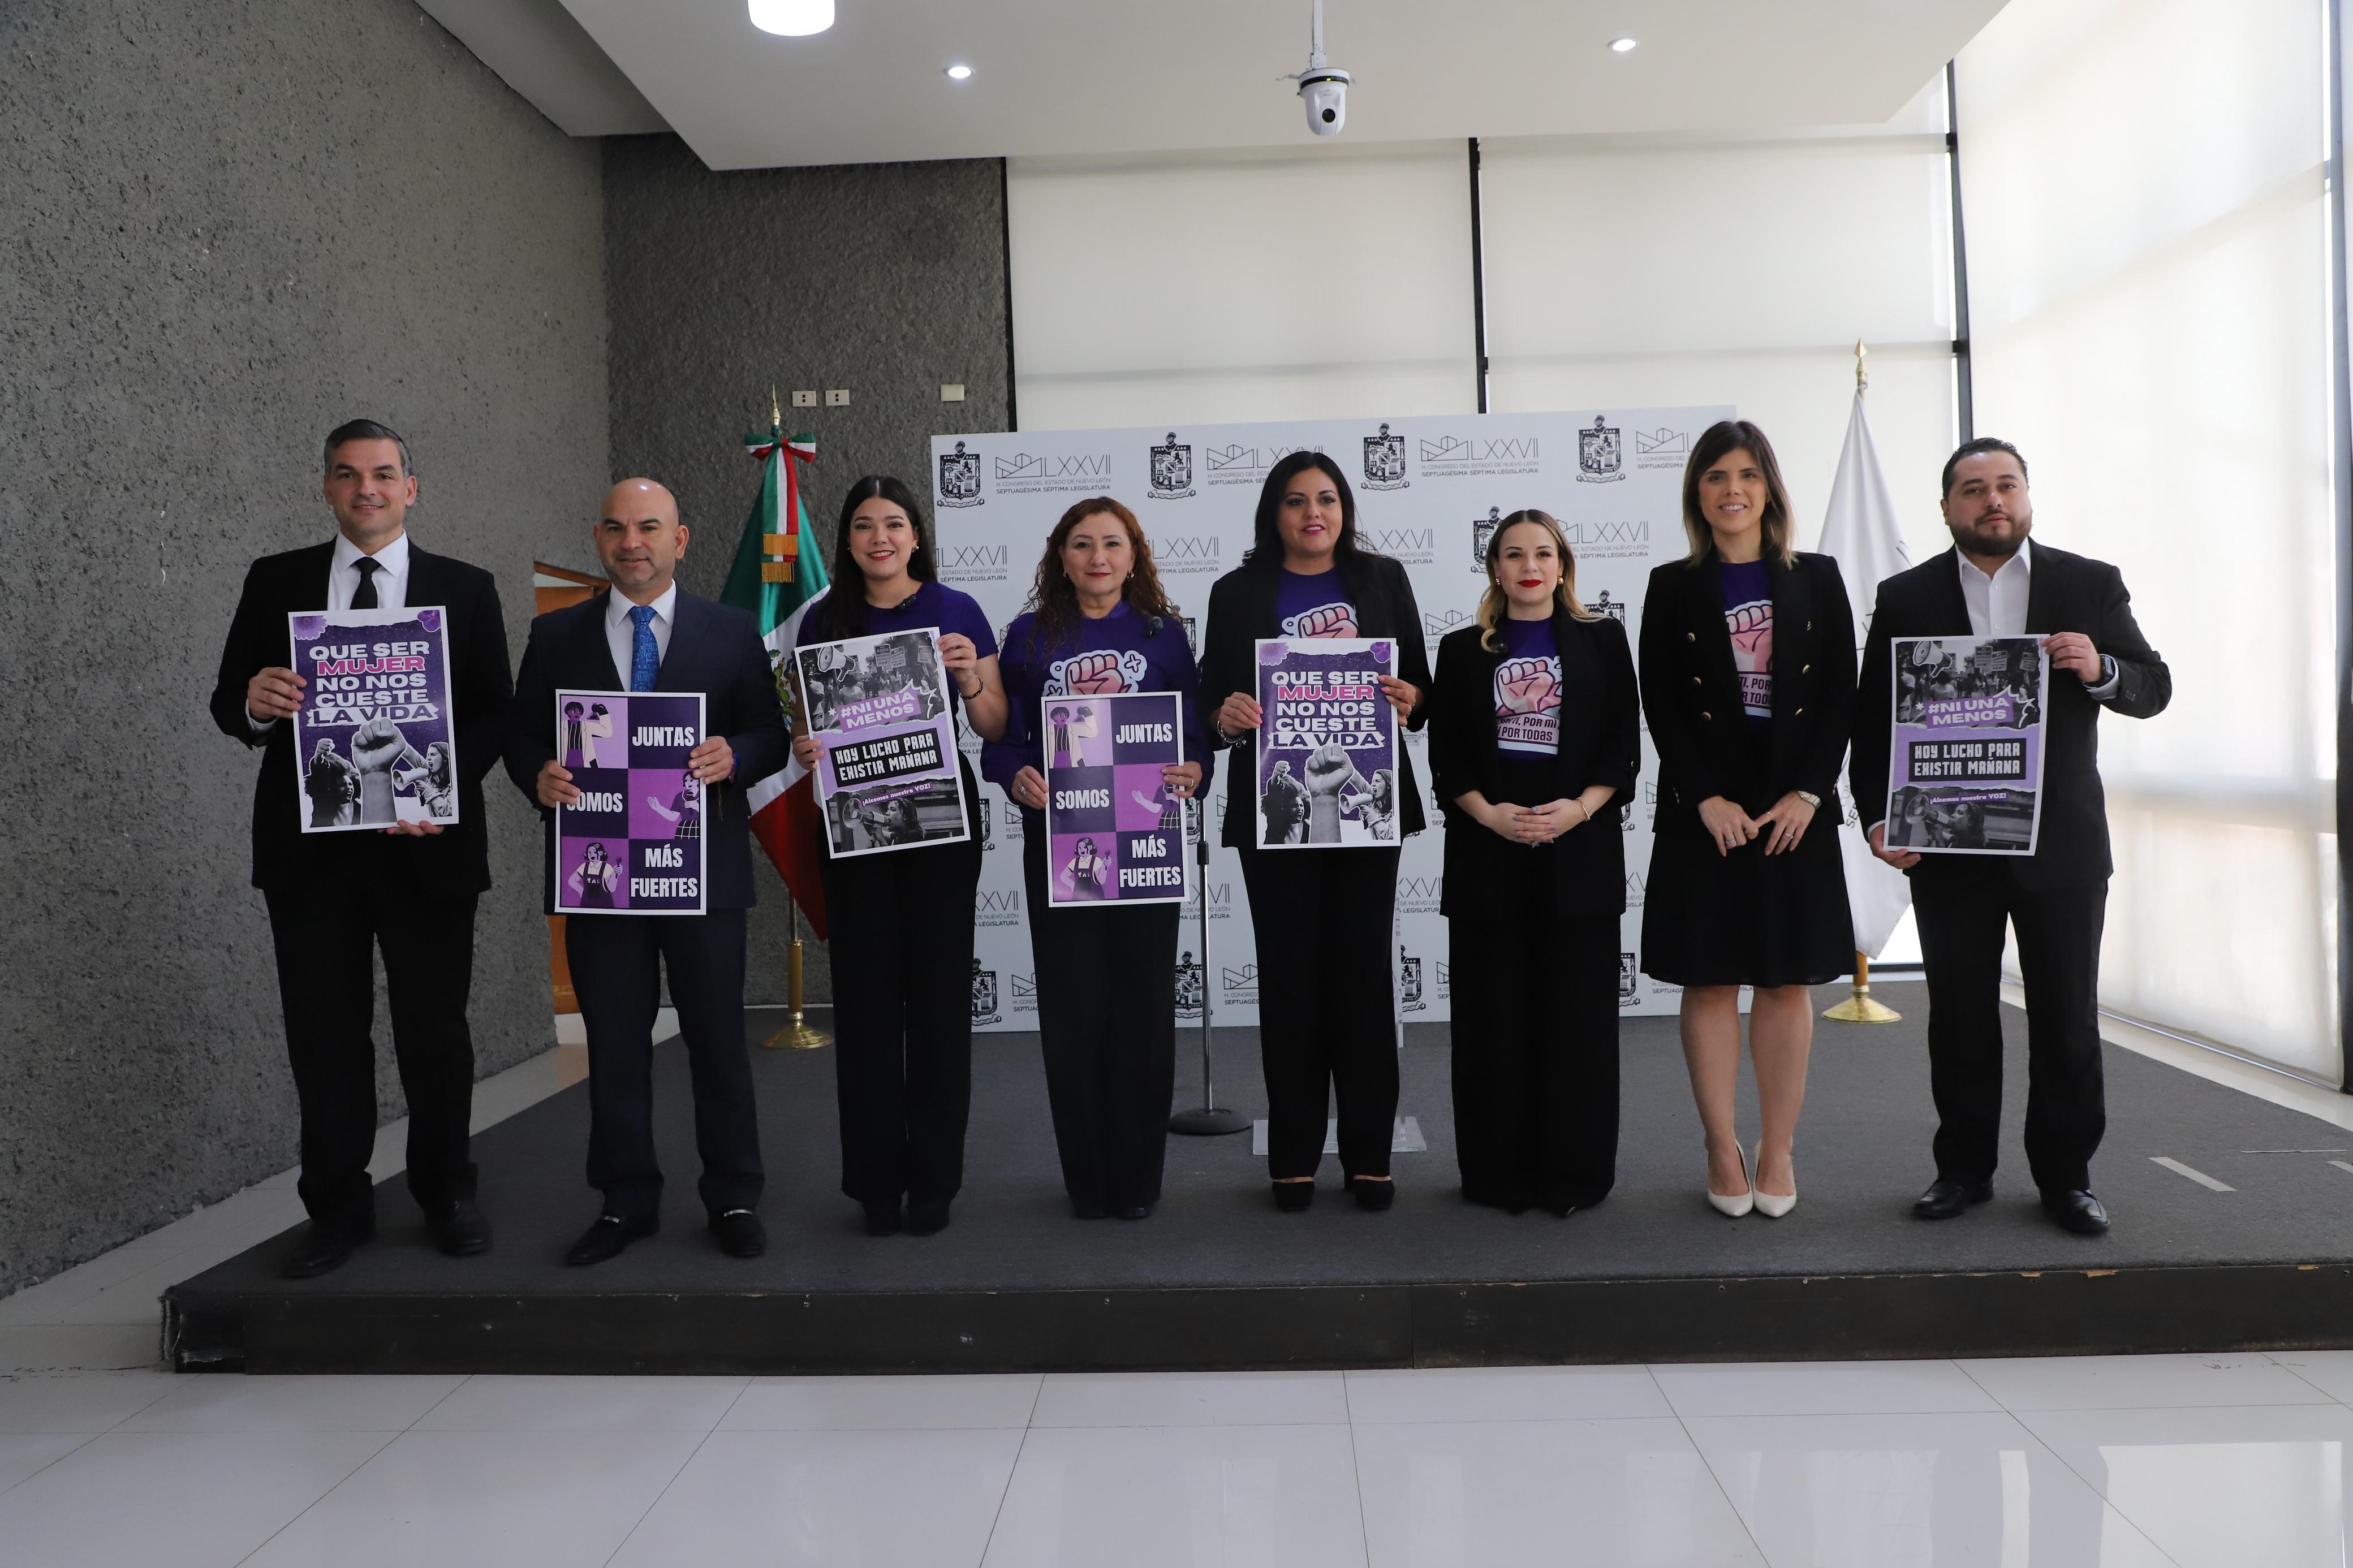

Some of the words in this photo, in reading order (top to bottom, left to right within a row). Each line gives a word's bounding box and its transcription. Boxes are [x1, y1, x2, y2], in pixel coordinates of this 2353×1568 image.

[1471, 438, 1538, 460] LXXVII
[1045, 455, 1111, 477] LXXVII
[1581, 521, 1648, 543] LXXVII
[942, 545, 1007, 567] LXXVII
[1152, 537, 1218, 559] LXXVII
[309, 643, 368, 661] QUE
[373, 641, 430, 657] SER
[317, 656, 425, 676] MUJER
[316, 676, 360, 692] NO
[365, 673, 426, 689] NOS
[1271, 671, 1324, 685] QUE
[1328, 671, 1379, 685] SER
[315, 688, 429, 708] CUESTE
[1278, 685, 1375, 701] MUJER
[1750, 692, 1768, 705] TOD
[313, 710, 354, 724] LA
[360, 705, 433, 721] VIDA
[841, 701, 872, 719] #NI
[873, 692, 915, 710] UNA
[1277, 702, 1315, 716] NO
[1320, 702, 1375, 716] NOS
[1928, 701, 1961, 714] #NI
[1967, 697, 2010, 710] UNA
[846, 703, 915, 729] MENOS
[1275, 718, 1376, 732] CUESTE
[1523, 716, 1543, 727] POR
[1932, 709, 2007, 726] MENOS
[632, 726, 695, 747] JUNTAS
[1115, 723, 1173, 744] JUNTAS
[1273, 734, 1308, 747] LA
[1316, 733, 1380, 746] VIDA
[1502, 727, 1520, 738] POR
[835, 748, 859, 764] HOY
[863, 739, 899, 759] LUCHO
[903, 733, 934, 751] PARA
[1914, 745, 1938, 759] HOY
[1943, 743, 1983, 758] LUCHO
[1988, 742, 2020, 757] PARA
[839, 761, 884, 781] EXISTIR
[889, 750, 937, 772] MAÑANA
[1914, 761, 1962, 776] EXISTIR
[1967, 756, 2020, 775] MAÑANA
[890, 788, 913, 798] nuestra
[914, 783, 931, 792] VOZ!
[1055, 788, 1110, 810] SOMOS
[1961, 794, 1986, 802] nuestra
[645, 843, 683, 868] MÁS
[1131, 834, 1167, 858] MÁS
[630, 877, 698, 897] FUERTES
[1119, 866, 1182, 888] FUERTES
